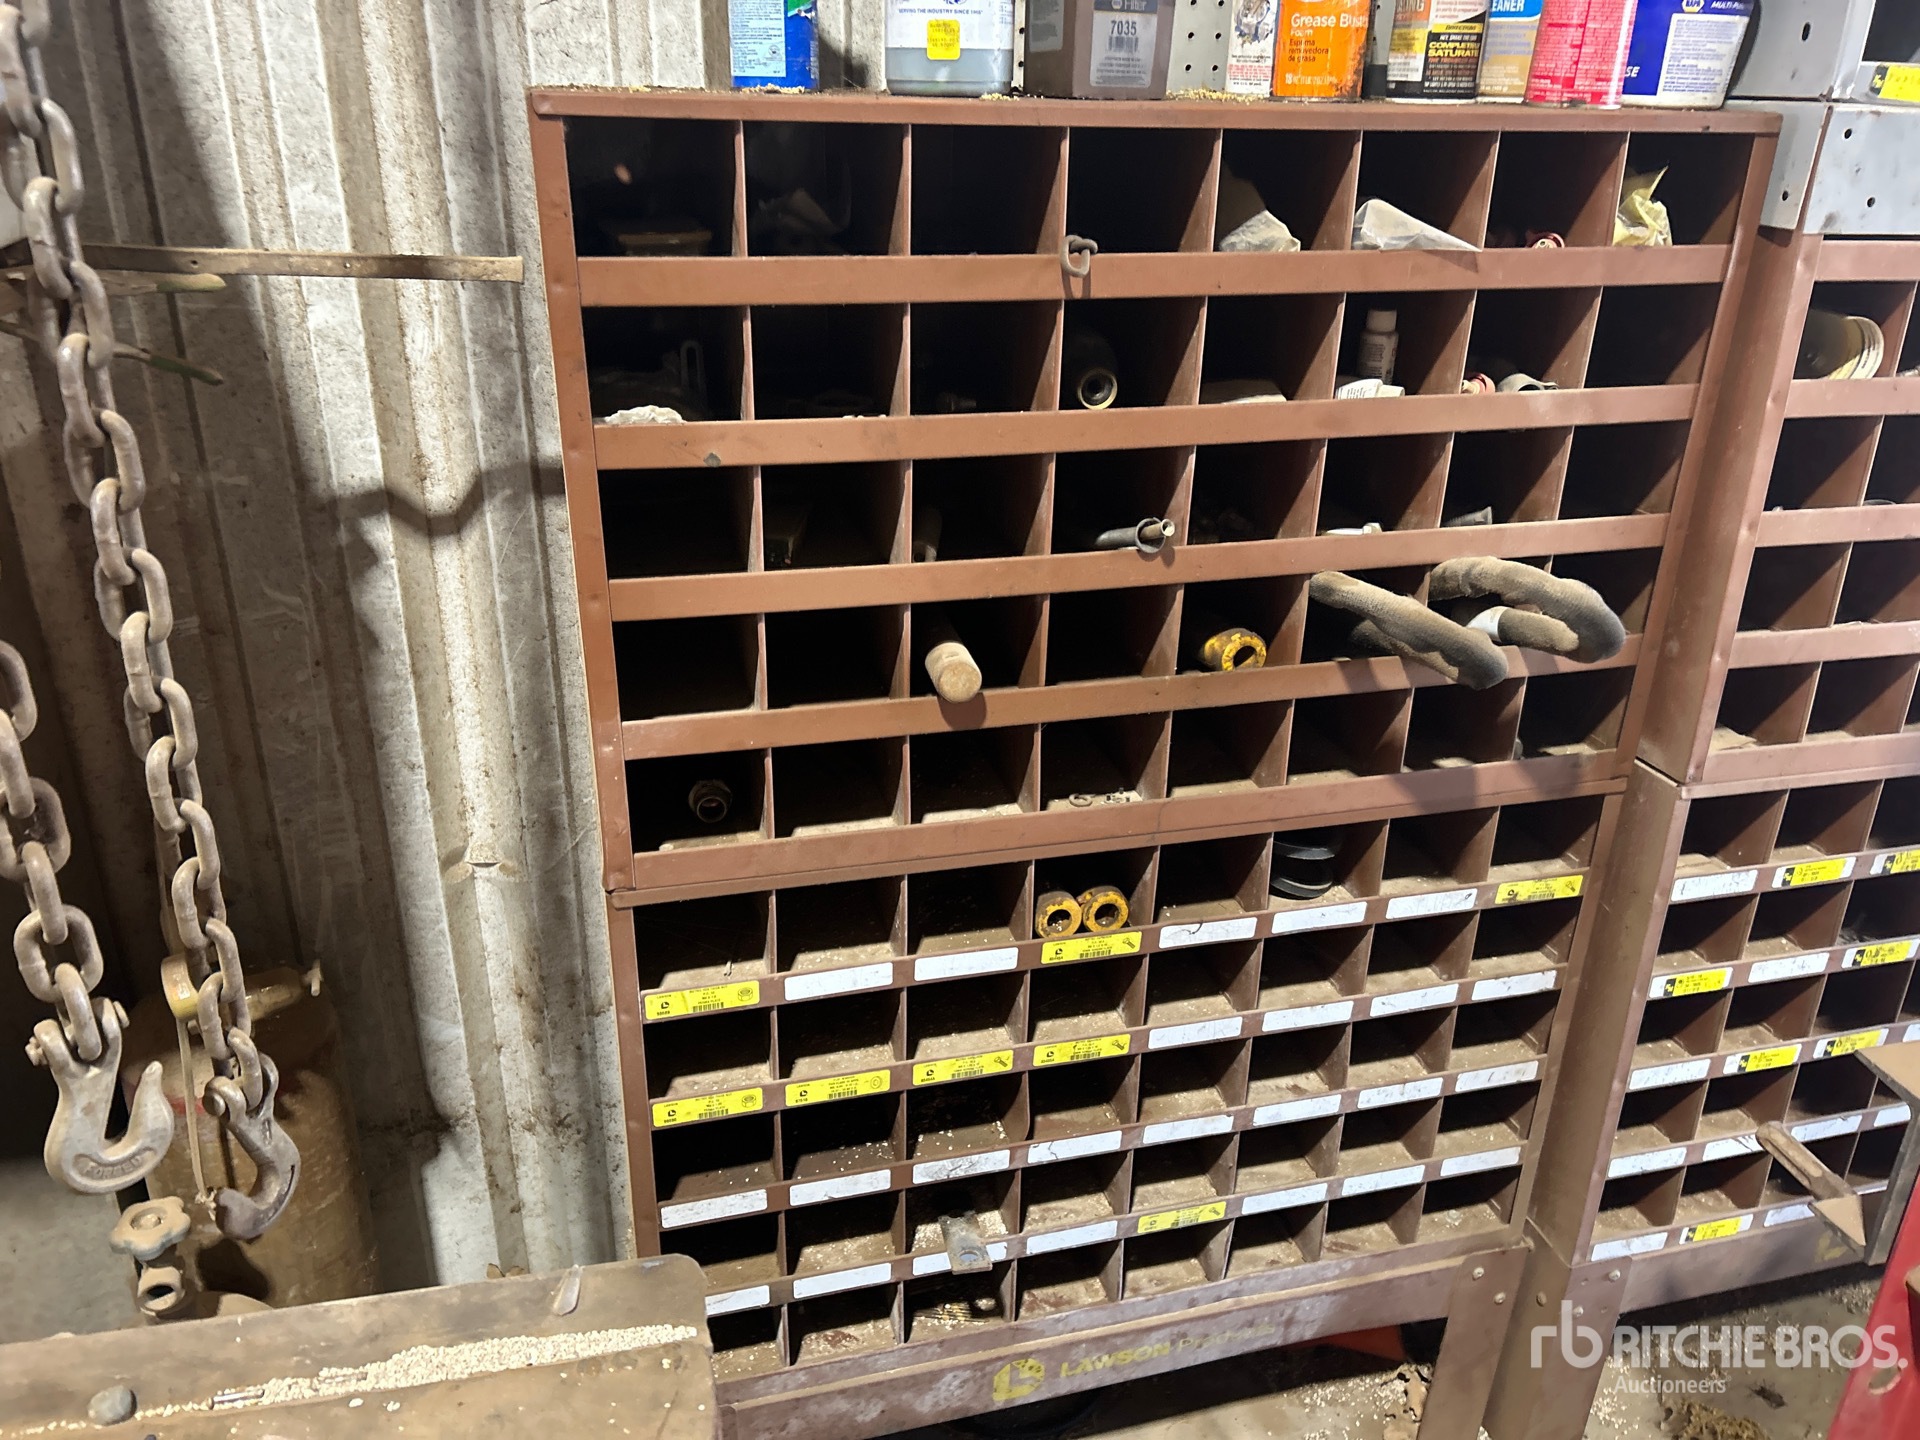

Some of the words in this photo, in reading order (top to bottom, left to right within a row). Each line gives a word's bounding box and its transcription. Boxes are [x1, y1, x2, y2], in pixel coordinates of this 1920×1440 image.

[1110, 20, 1137, 36] 7035
[1290, 12, 1337, 28] Grease
[1061, 1342, 1171, 1377] LAWSON
